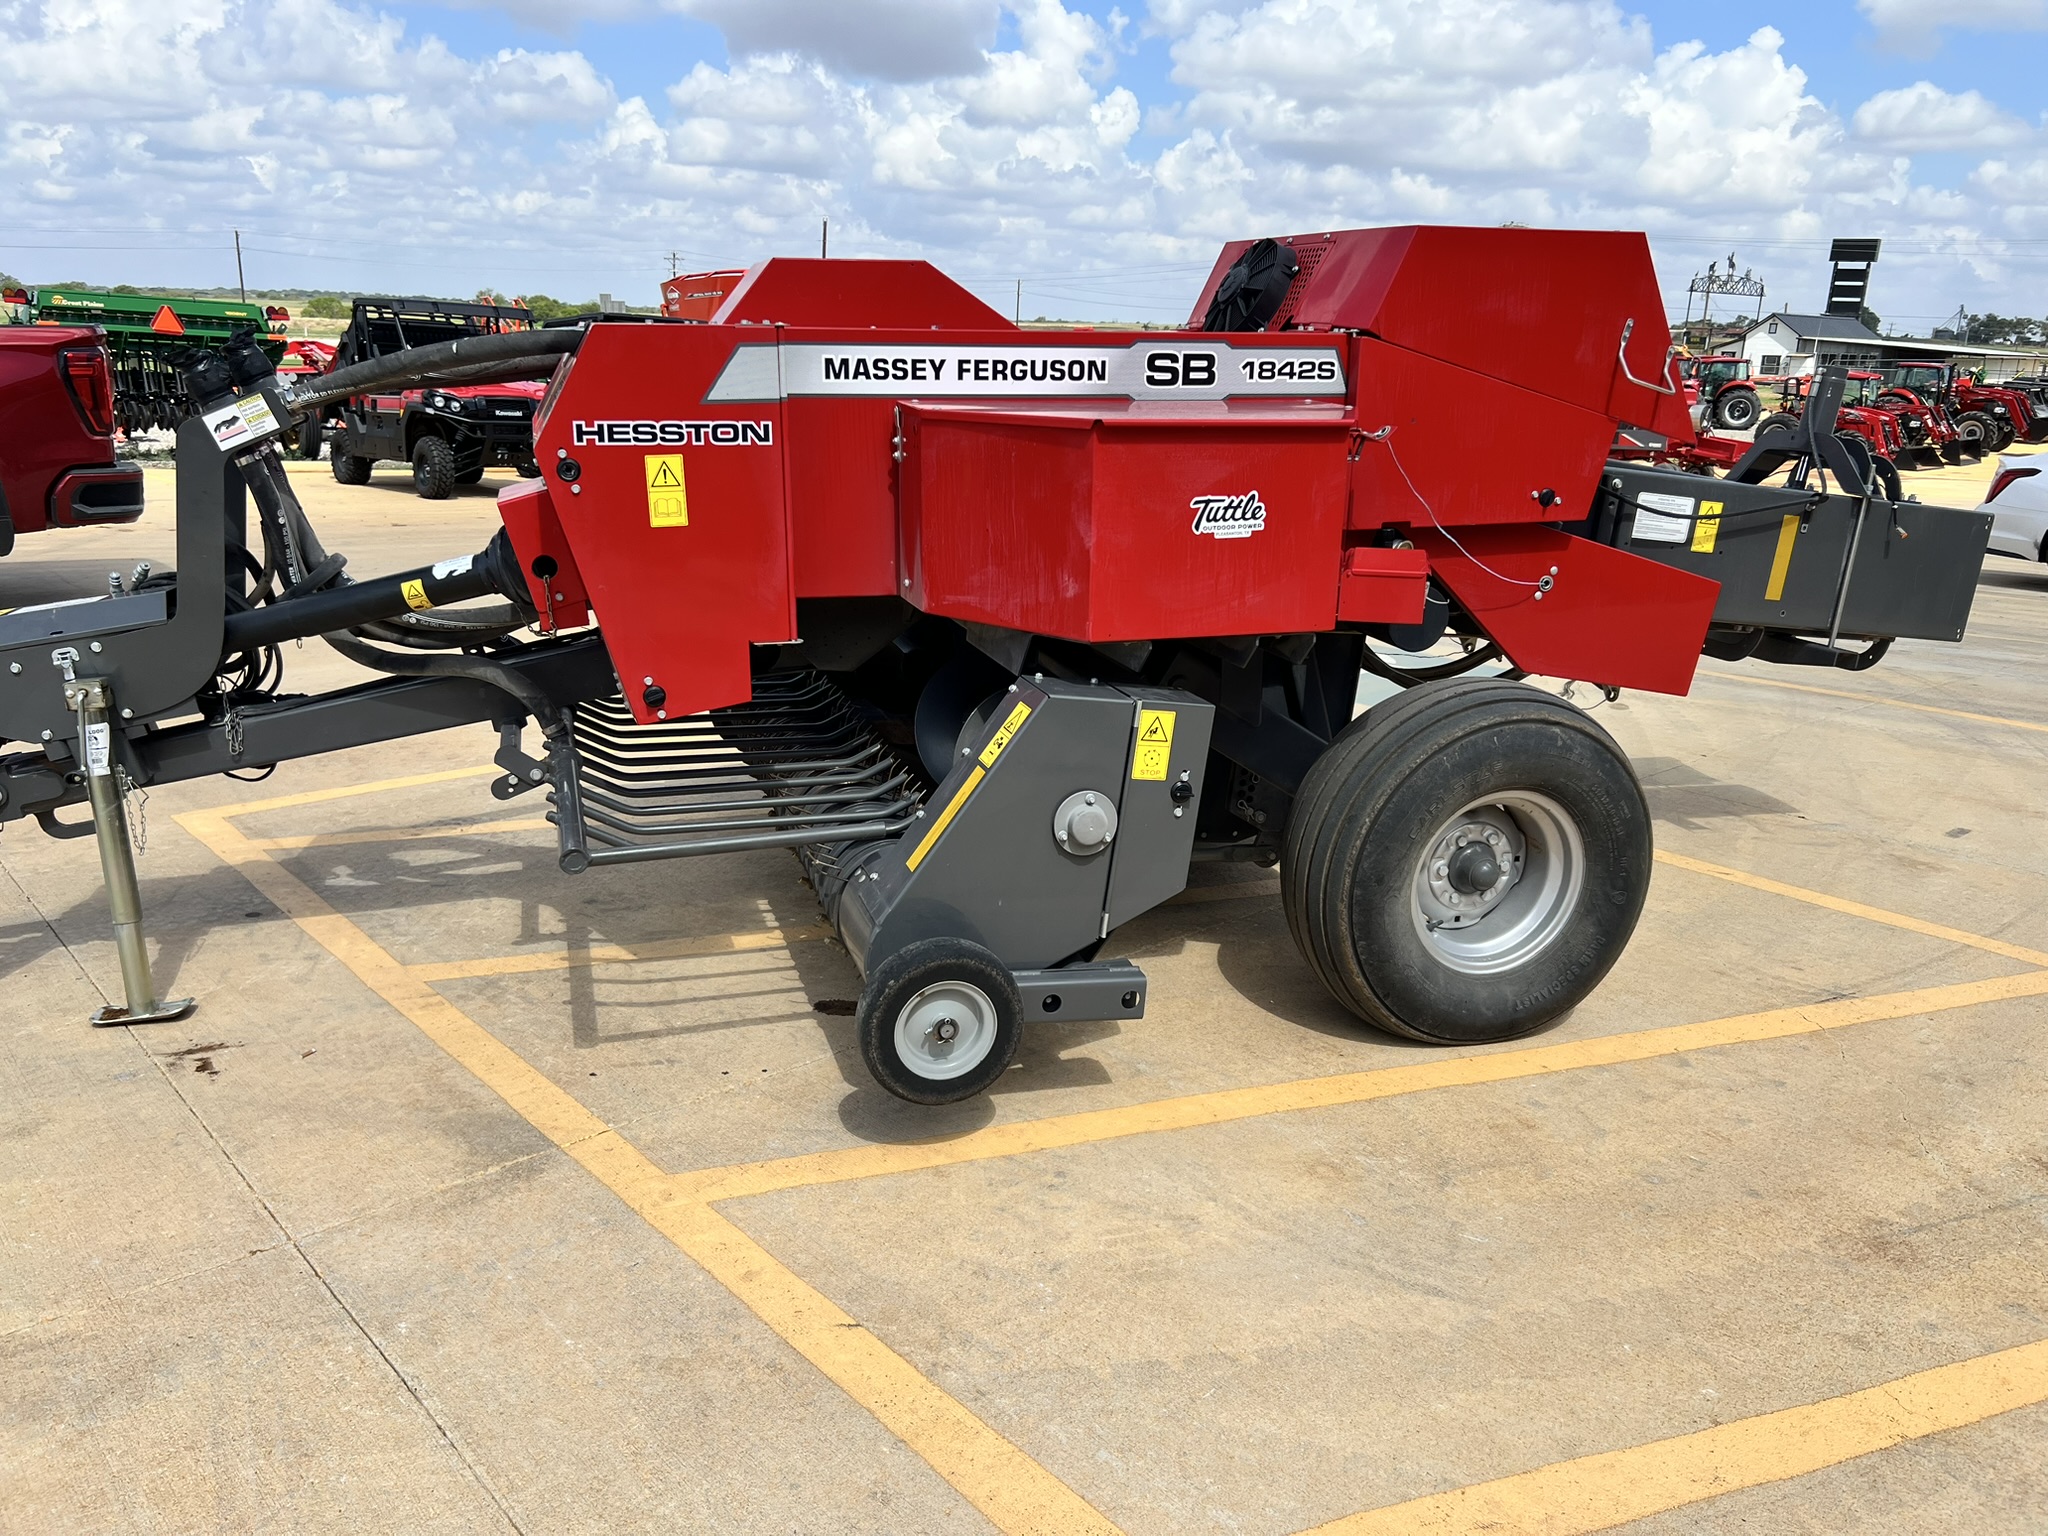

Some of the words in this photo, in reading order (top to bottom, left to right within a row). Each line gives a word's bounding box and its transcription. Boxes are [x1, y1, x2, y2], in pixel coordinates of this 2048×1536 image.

[824, 357, 946, 381] MASSEY
[956, 359, 1107, 382] FERGUSON
[1145, 352, 1216, 387] SB
[1241, 361, 1336, 381] 1842S
[574, 422, 772, 445] HESSTON
[1192, 493, 1264, 532] Tuttle
[1514, 964, 1581, 1011] SPECIALIST
